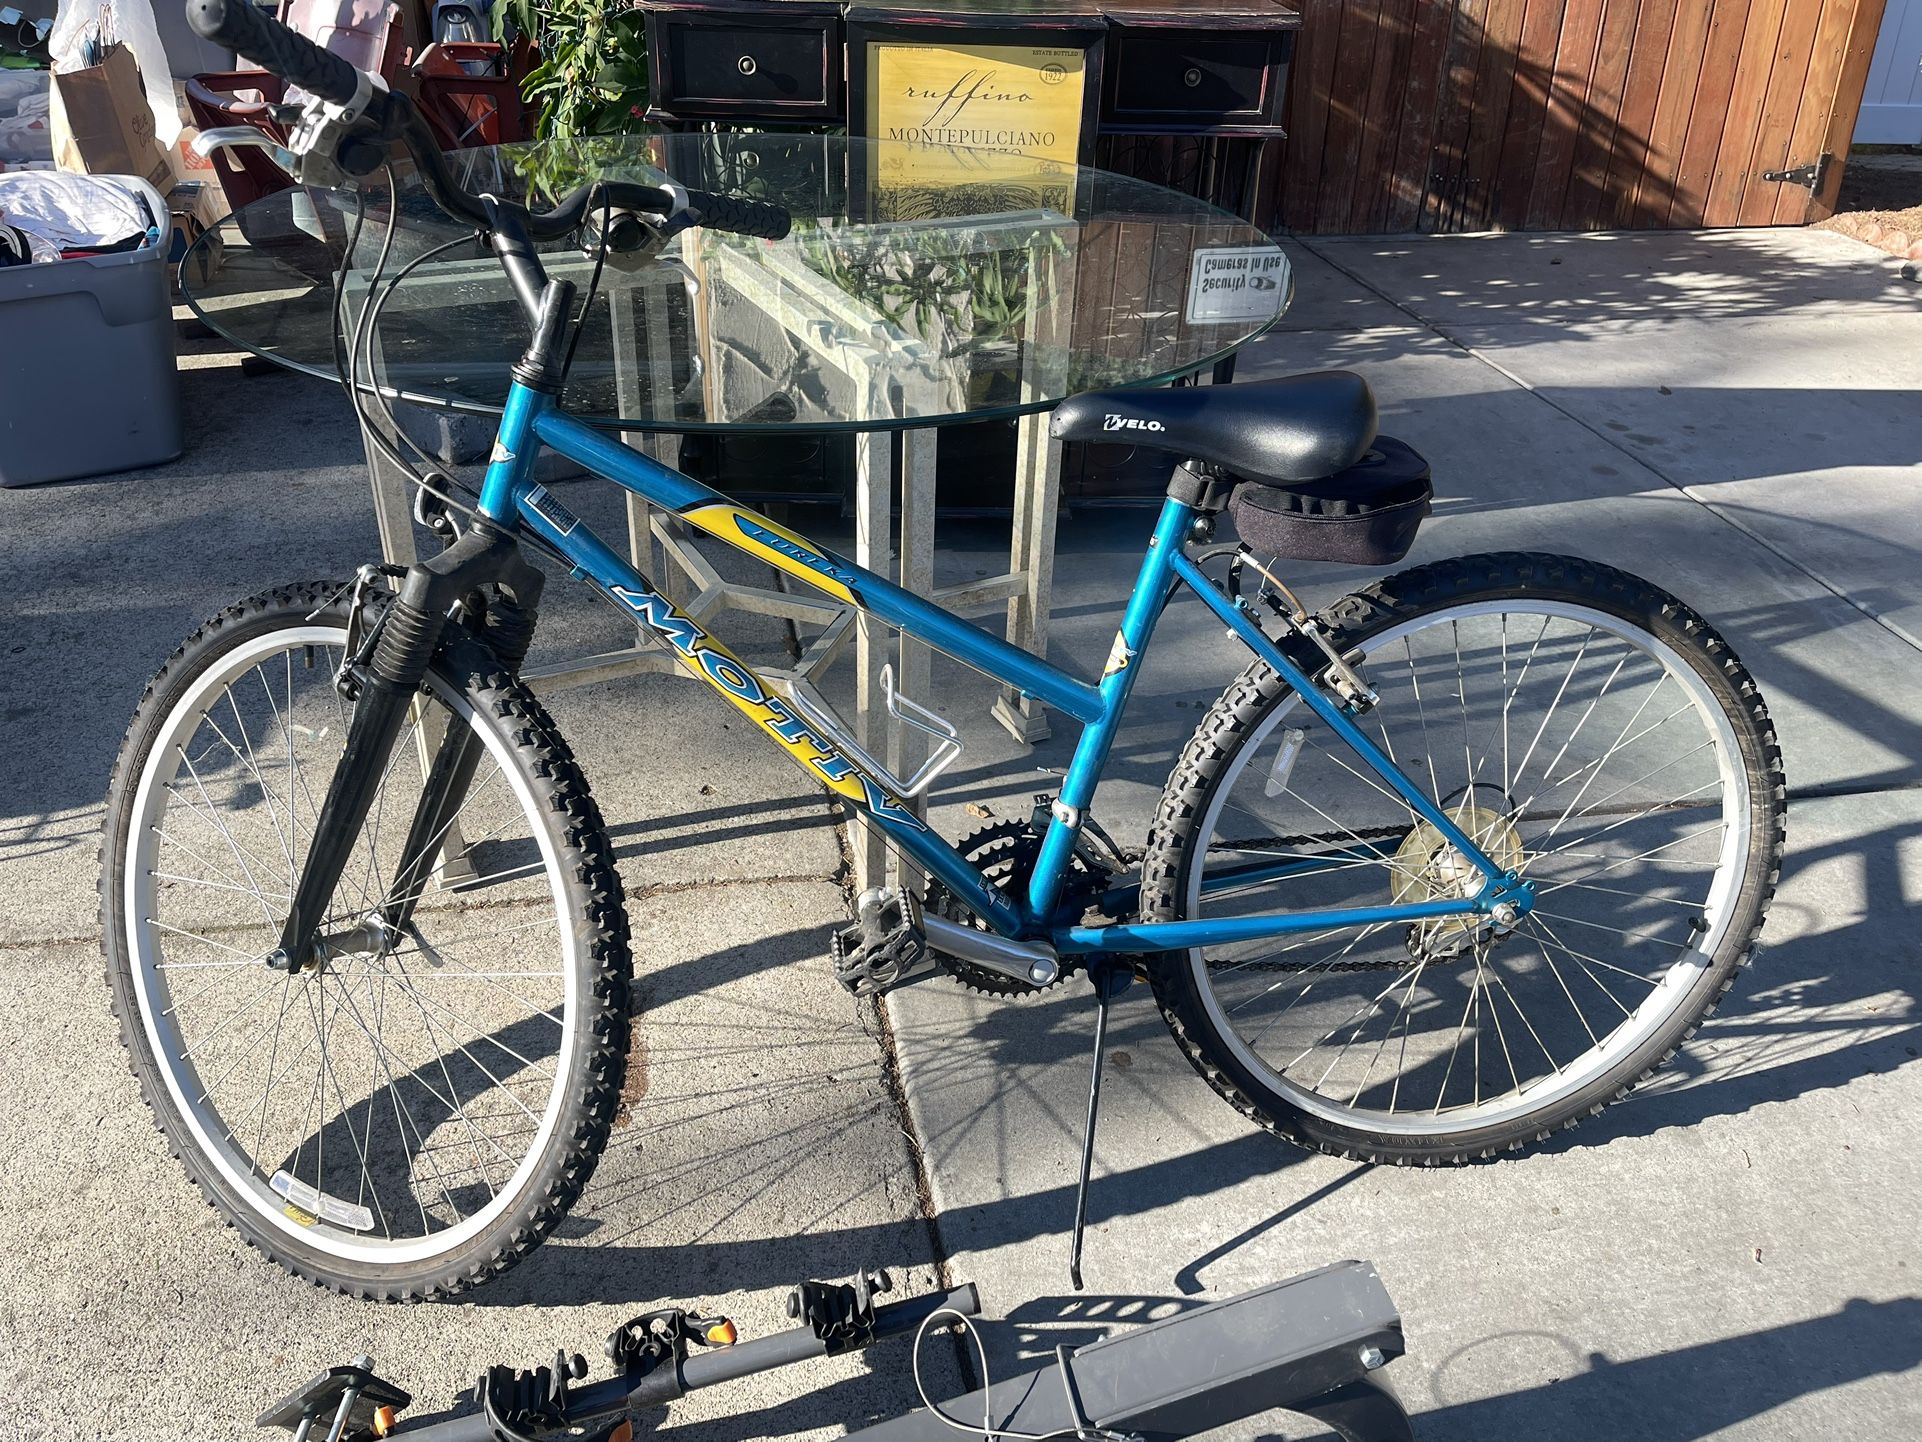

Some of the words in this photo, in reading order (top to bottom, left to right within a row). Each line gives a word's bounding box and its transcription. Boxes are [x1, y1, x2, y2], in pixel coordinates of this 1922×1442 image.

[903, 68, 1034, 127] ruffino
[889, 127, 1055, 147] MONTEPULCIANO
[610, 585, 928, 833] MOTIV
